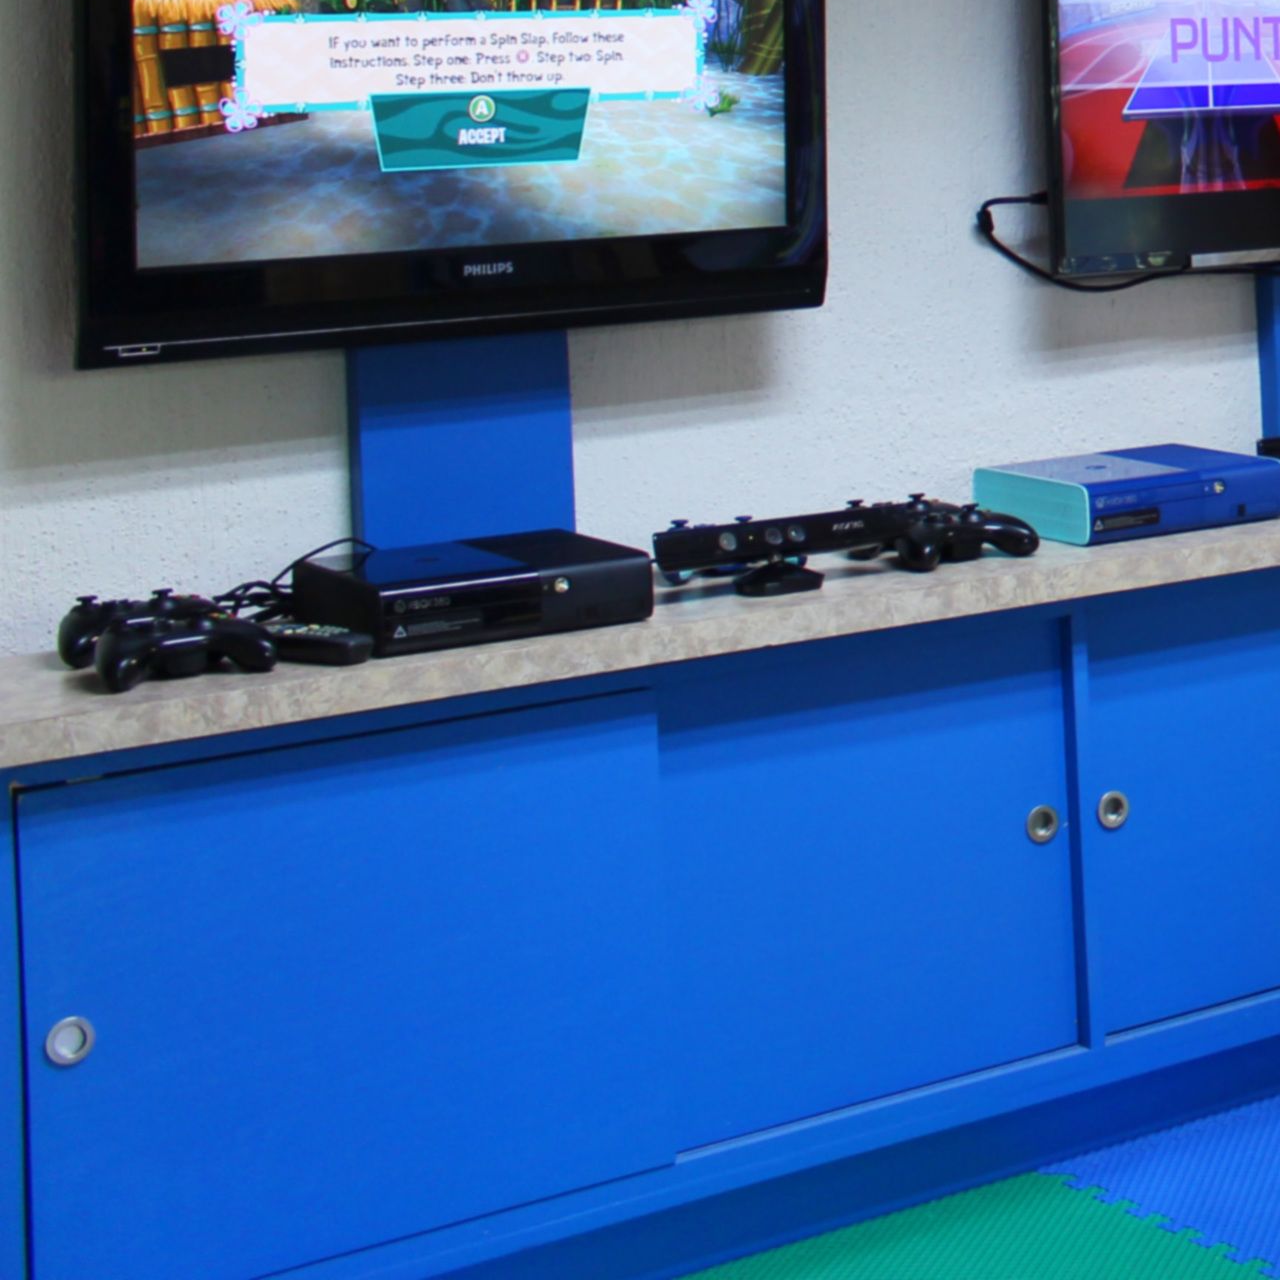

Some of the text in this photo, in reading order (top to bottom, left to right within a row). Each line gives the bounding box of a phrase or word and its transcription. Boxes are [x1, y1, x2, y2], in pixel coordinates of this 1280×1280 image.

[343, 38, 367, 52] you
[370, 36, 401, 48] want
[404, 35, 418, 47] to
[422, 33, 477, 51] perform
[480, 36, 488, 45] a
[490, 32, 518, 49] Spin
[592, 30, 625, 43] these
[413, 53, 443, 70] Step
[475, 52, 511, 65] Press
[537, 50, 565, 66] Step
[396, 73, 426, 89] Step
[470, 70, 503, 84] Don't
[507, 69, 543, 83] throw
[458, 127, 507, 145] ACCEPT
[463, 261, 514, 277] PHILIPS
